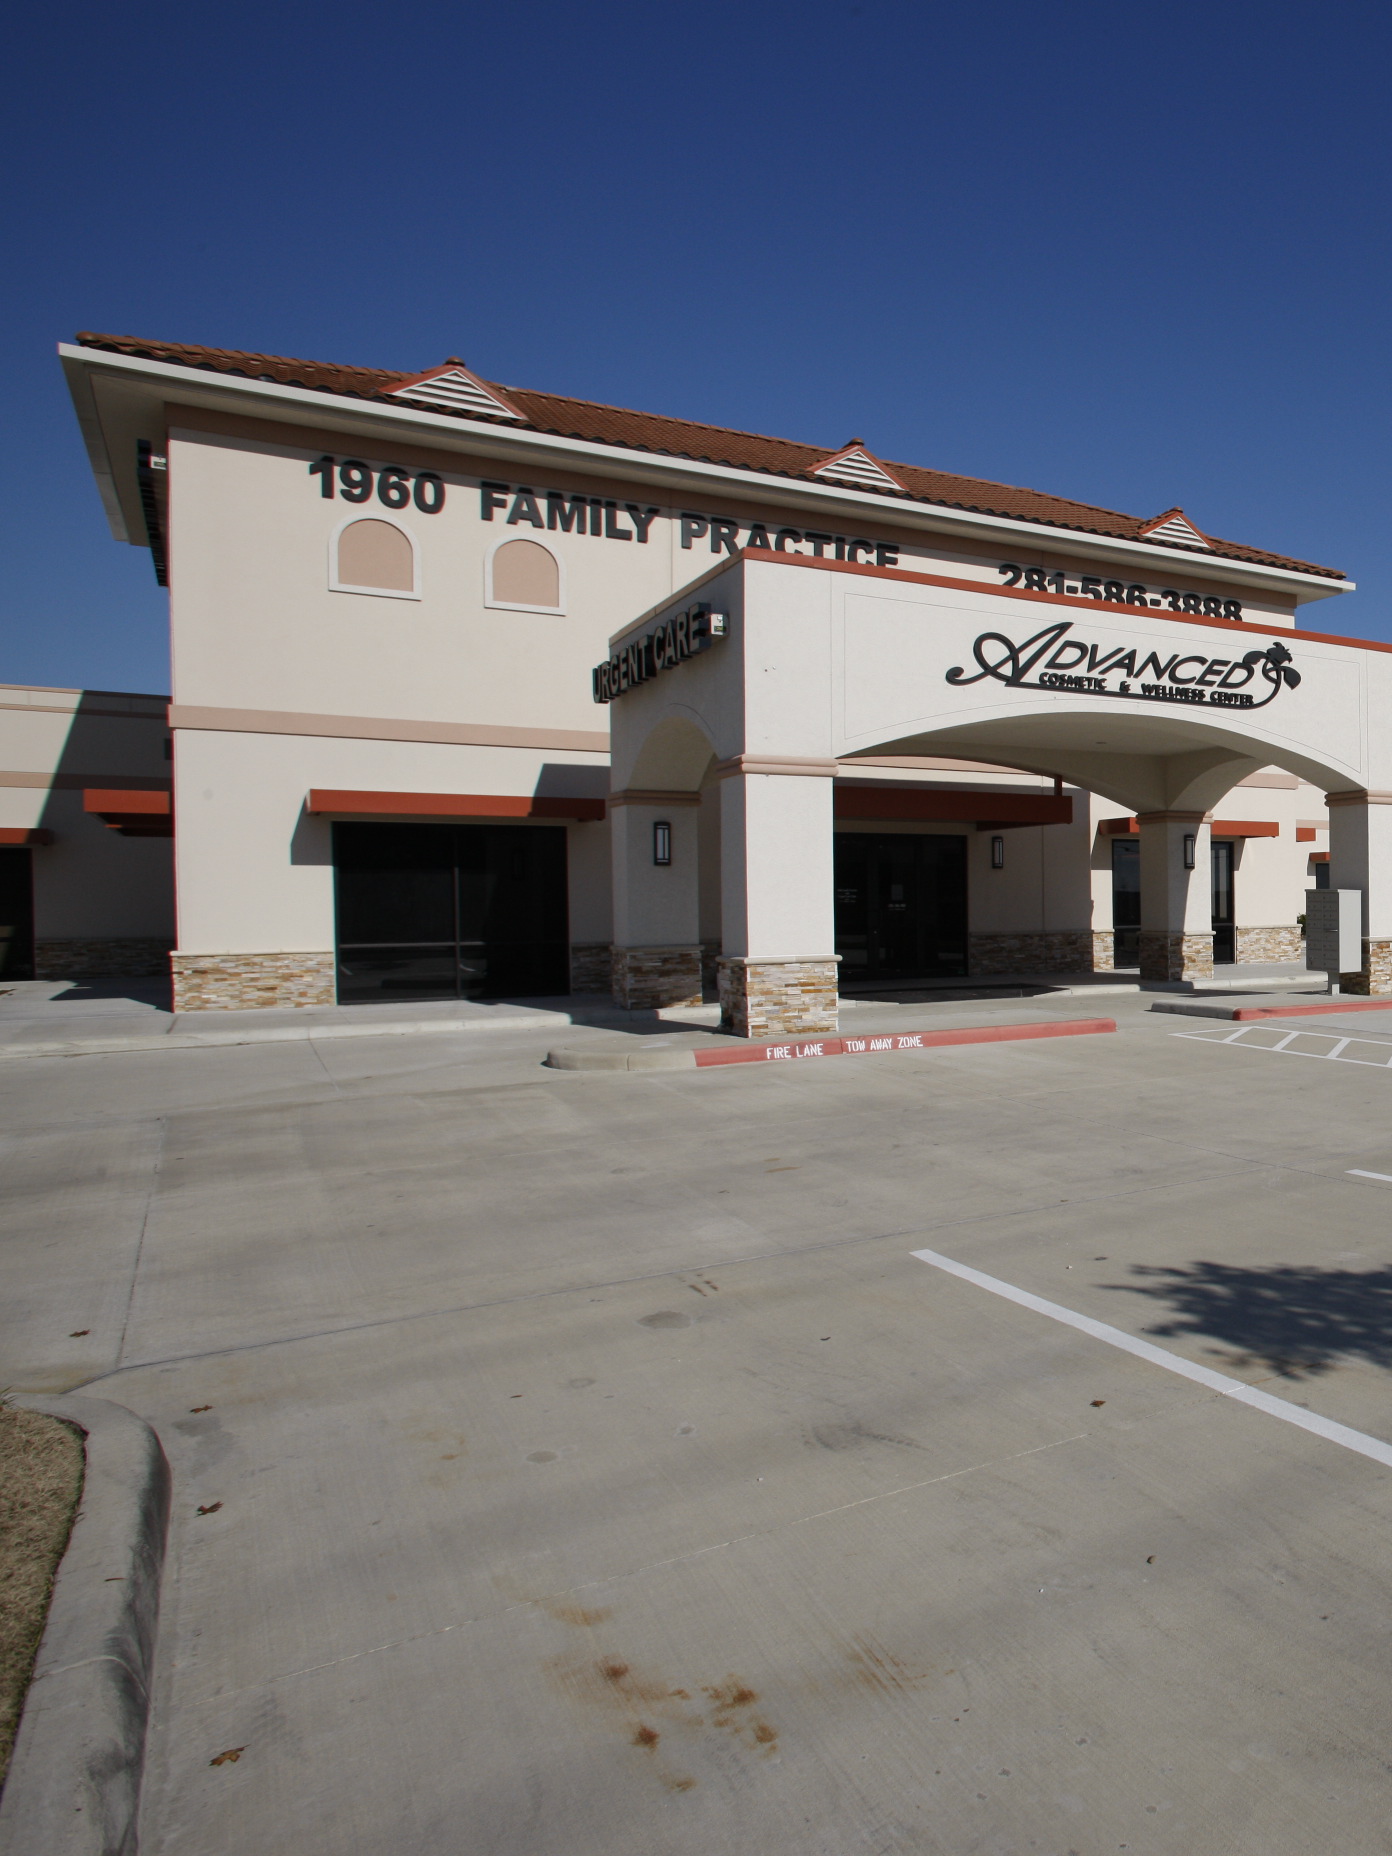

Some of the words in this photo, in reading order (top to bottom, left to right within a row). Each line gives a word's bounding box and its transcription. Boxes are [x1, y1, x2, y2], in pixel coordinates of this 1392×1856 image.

[309, 455, 447, 515] 1960
[480, 480, 661, 544] FAMILY
[998, 563, 1243, 622] 281-586-3888
[592, 634, 653, 704] URGENT
[653, 602, 706, 670] CARE
[1039, 672, 1108, 691] COSMETIC
[1119, 680, 1132, 693] &
[1140, 683, 1207, 700] WELLNESS
[1210, 690, 1255, 705] CENTER
[766, 1046, 792, 1060] FIRE
[796, 1043, 824, 1058] LANE
[846, 1040, 866, 1053] TOW
[870, 1037, 893, 1051] AWAY
[897, 1035, 924, 1049] ZONE
